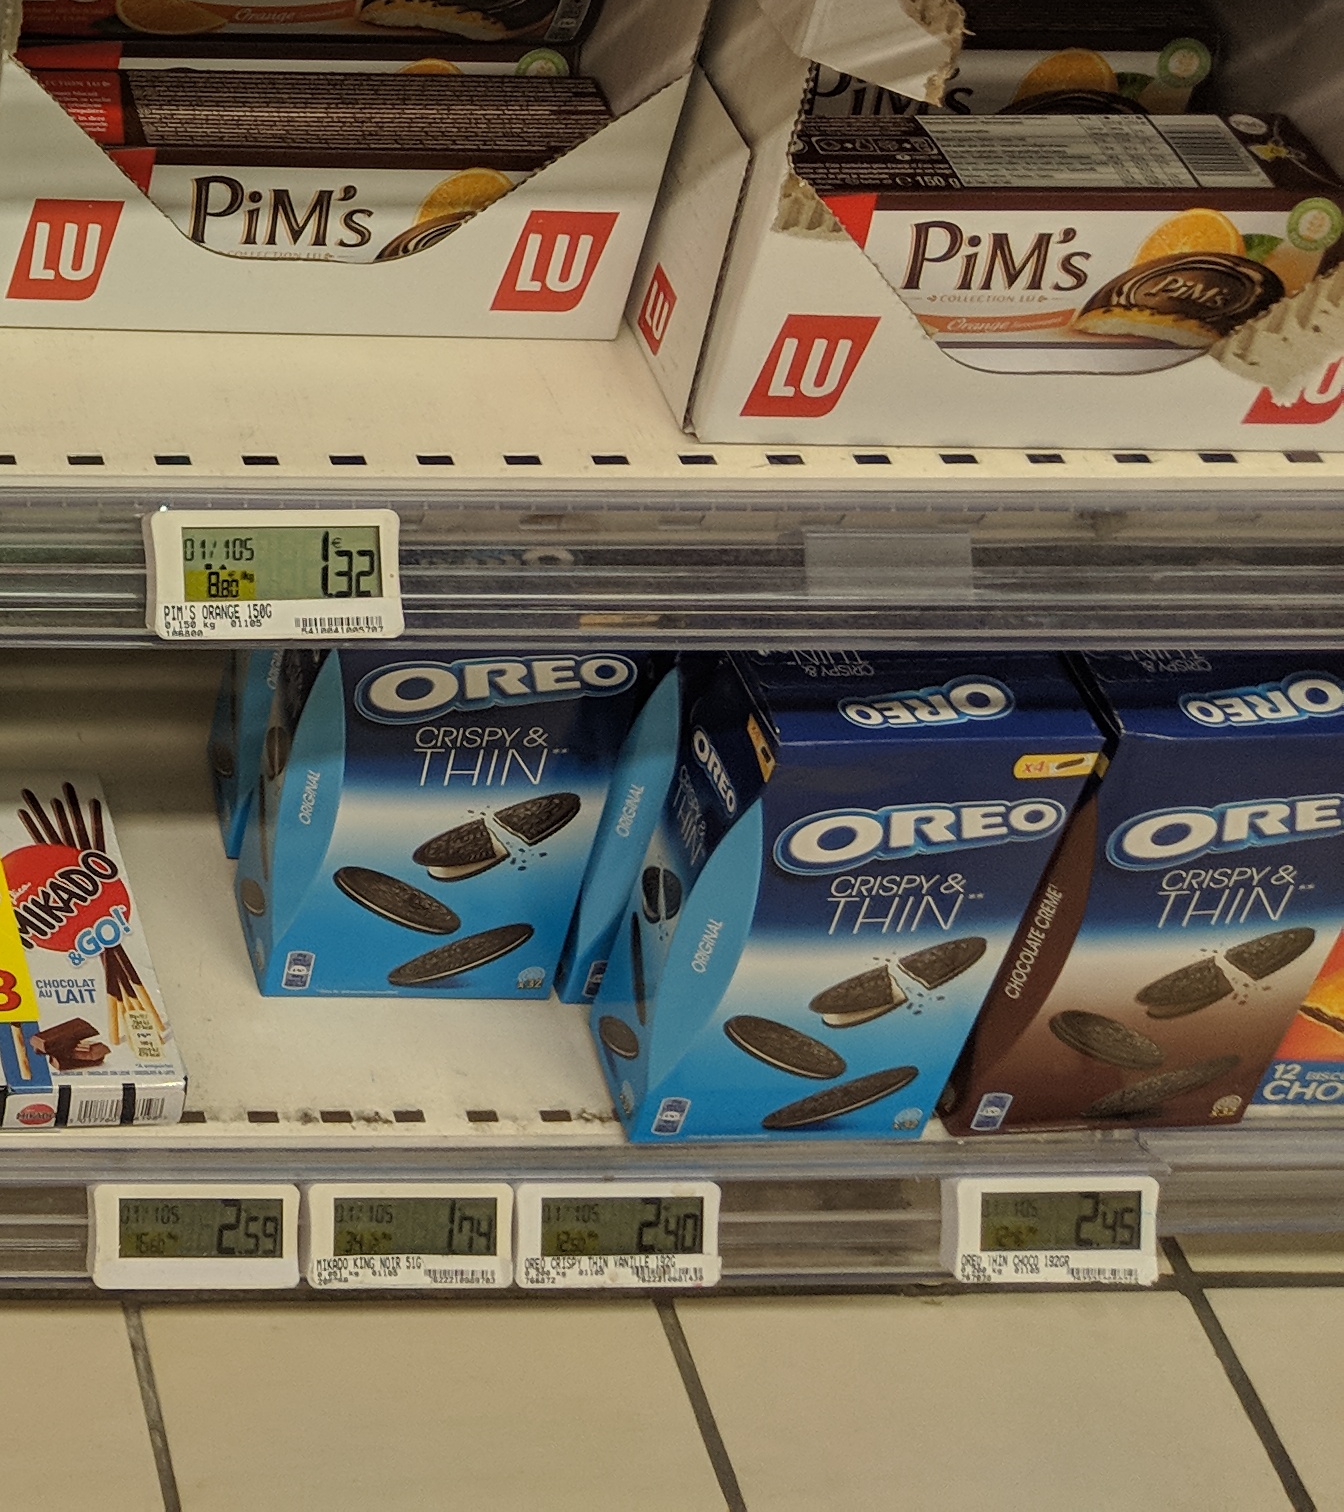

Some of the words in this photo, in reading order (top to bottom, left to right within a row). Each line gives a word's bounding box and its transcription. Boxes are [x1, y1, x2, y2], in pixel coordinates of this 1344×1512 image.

[190, 174, 373, 248] PiM's
[901, 220, 1092, 291] PiM's
[164, 606, 196, 620] PIM'S
[202, 605, 240, 620] ORANGE
[247, 604, 272, 619] 150G
[204, 621, 216, 630] kg
[230, 619, 262, 628] 01105
[360, 657, 633, 722] OREO
[777, 799, 1065, 871] OREO
[830, 874, 937, 897] CRISPY
[939, 874, 966, 894] &
[1161, 869, 1269, 891] CRISPY
[1270, 865, 1297, 885] &
[827, 895, 964, 935] THIN
[36, 979, 96, 989] CHOCOLAT
[1274, 1064, 1301, 1079] 12
[317, 1259, 348, 1270] MIKADO
[353, 1258, 375, 1269] KING
[380, 1257, 401, 1269] NOIR
